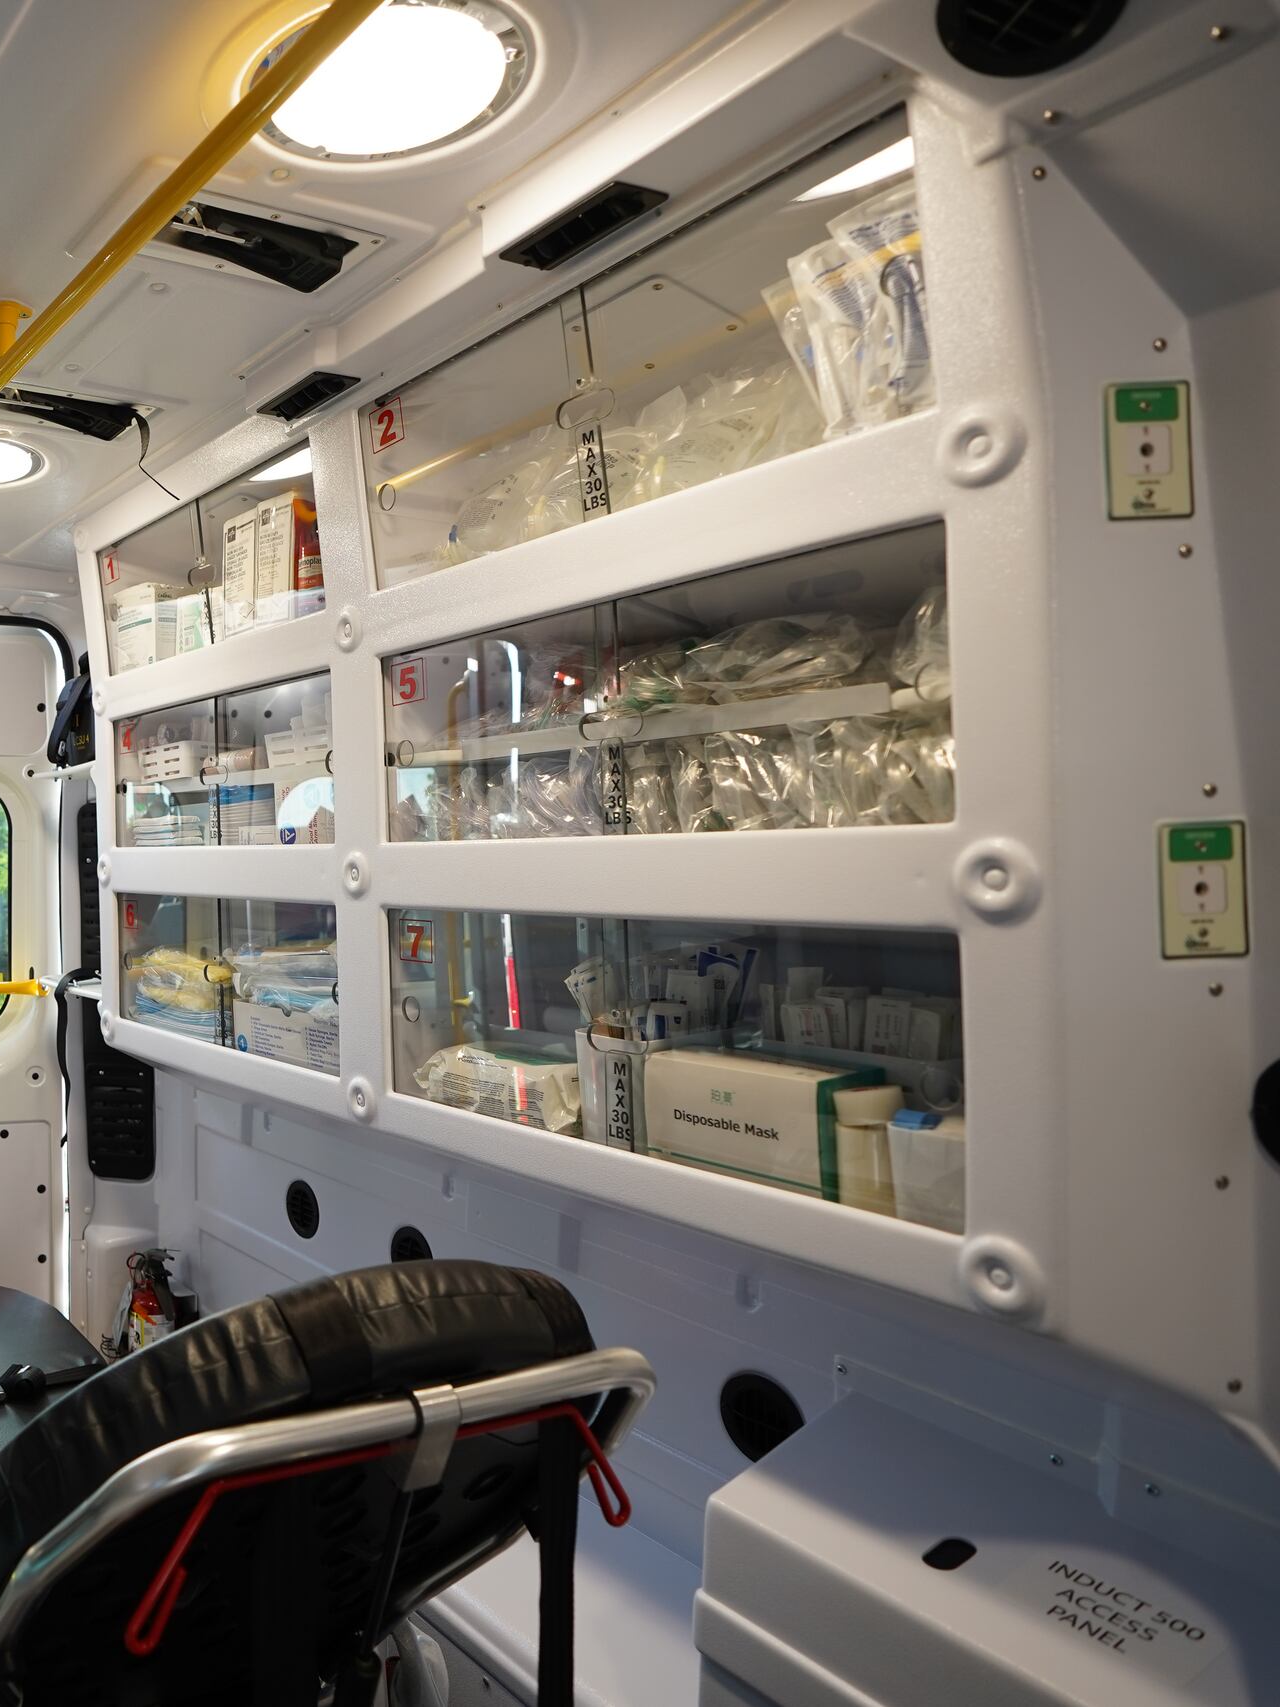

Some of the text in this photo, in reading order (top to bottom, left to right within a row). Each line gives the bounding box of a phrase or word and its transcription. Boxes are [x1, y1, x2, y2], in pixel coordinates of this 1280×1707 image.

[377, 409, 397, 447] 2
[585, 477, 603, 495] 30
[583, 492, 608, 512] LBS
[107, 557, 115, 580] 1
[399, 665, 417, 700] 5
[122, 727, 131, 751] 4
[605, 811, 631, 825] LBS
[126, 903, 135, 927] 6
[407, 925, 425, 958] 7
[613, 1061, 626, 1109] MAX
[611, 1109, 629, 1125] 30
[673, 1108, 780, 1141] Disposable Mask
[608, 1123, 632, 1142] LBS
[1048, 1560, 1206, 1641] INDUCT 500
[1055, 1588, 1159, 1642] ACCESS
[1046, 1604, 1126, 1655] PANEL
